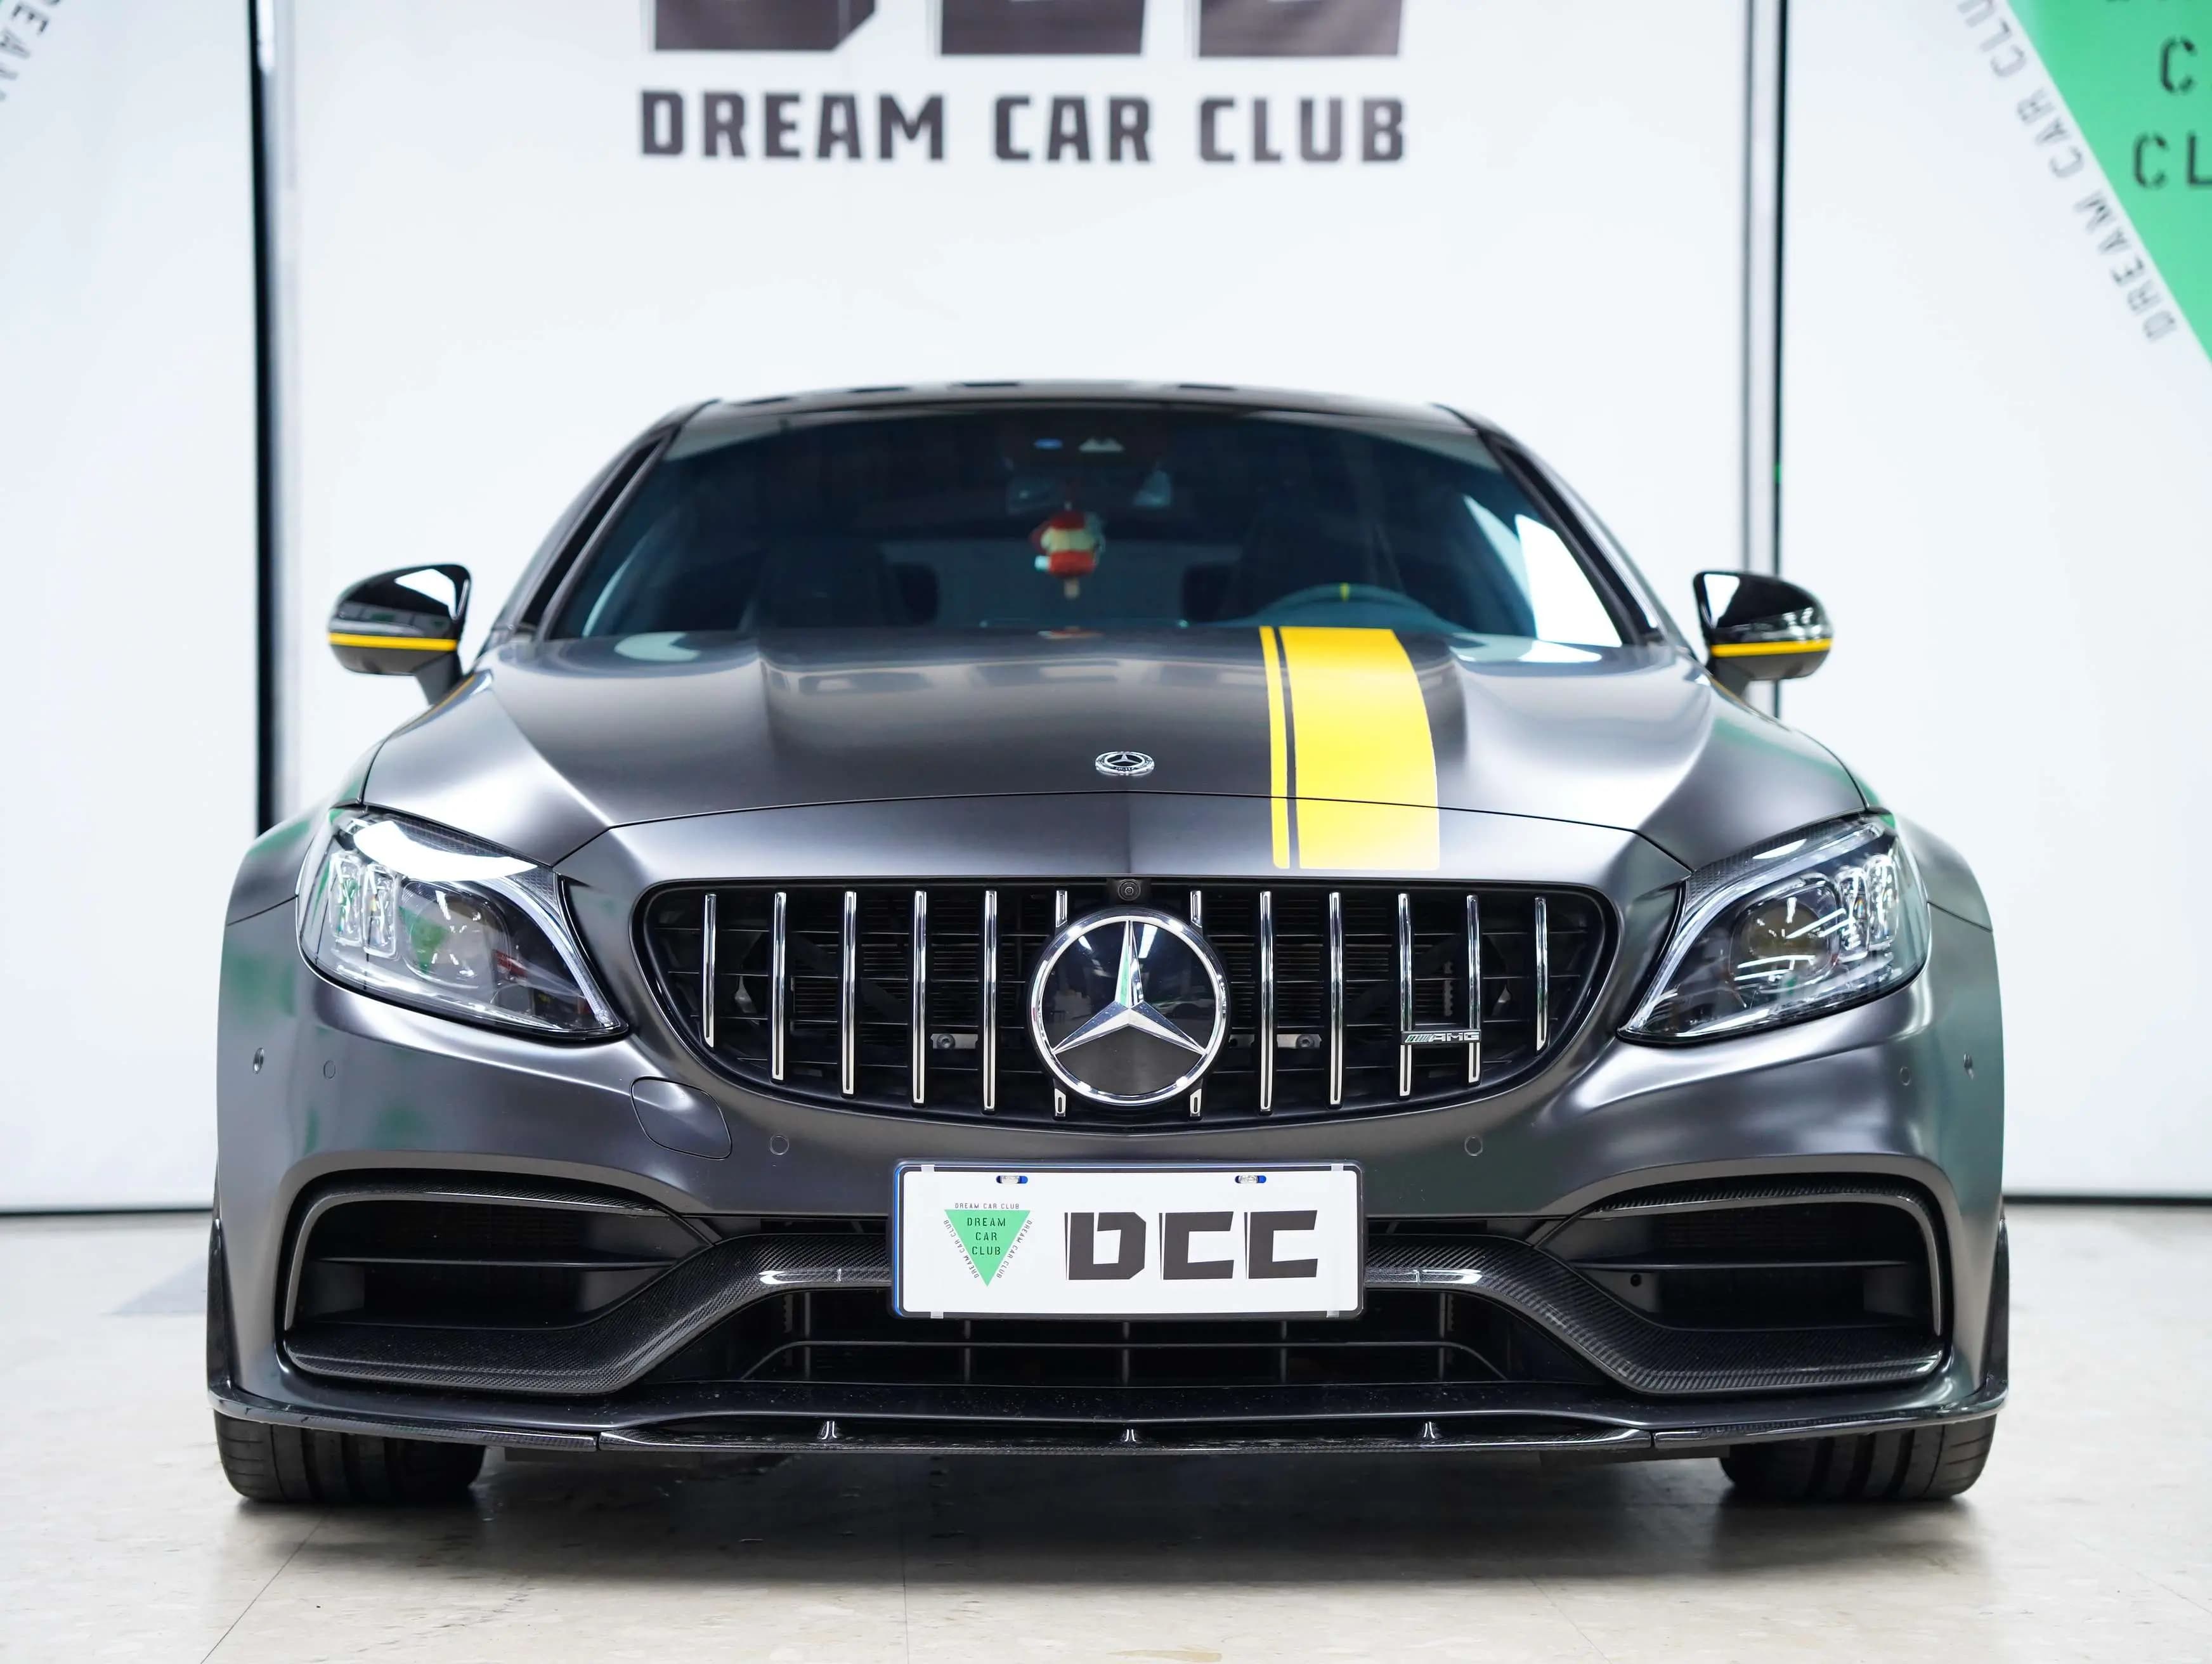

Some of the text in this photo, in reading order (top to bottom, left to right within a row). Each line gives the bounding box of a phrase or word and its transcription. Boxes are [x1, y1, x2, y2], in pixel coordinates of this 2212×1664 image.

[641, 90, 1405, 163] DREAM CAR CLUB
[2017, 87, 2085, 178] CAR
[2073, 190, 2178, 341] DREAM
[1428, 1032, 1480, 1042] AMG
[943, 1219, 980, 1278] DREAM CAR CLUB
[967, 1217, 1006, 1226] DREAM
[972, 1246, 1001, 1256] CLUB
[975, 1232, 998, 1241] CAR
[996, 1219, 1032, 1278] DREAM CAR CLUB
[1065, 1210, 1318, 1280] DCC
